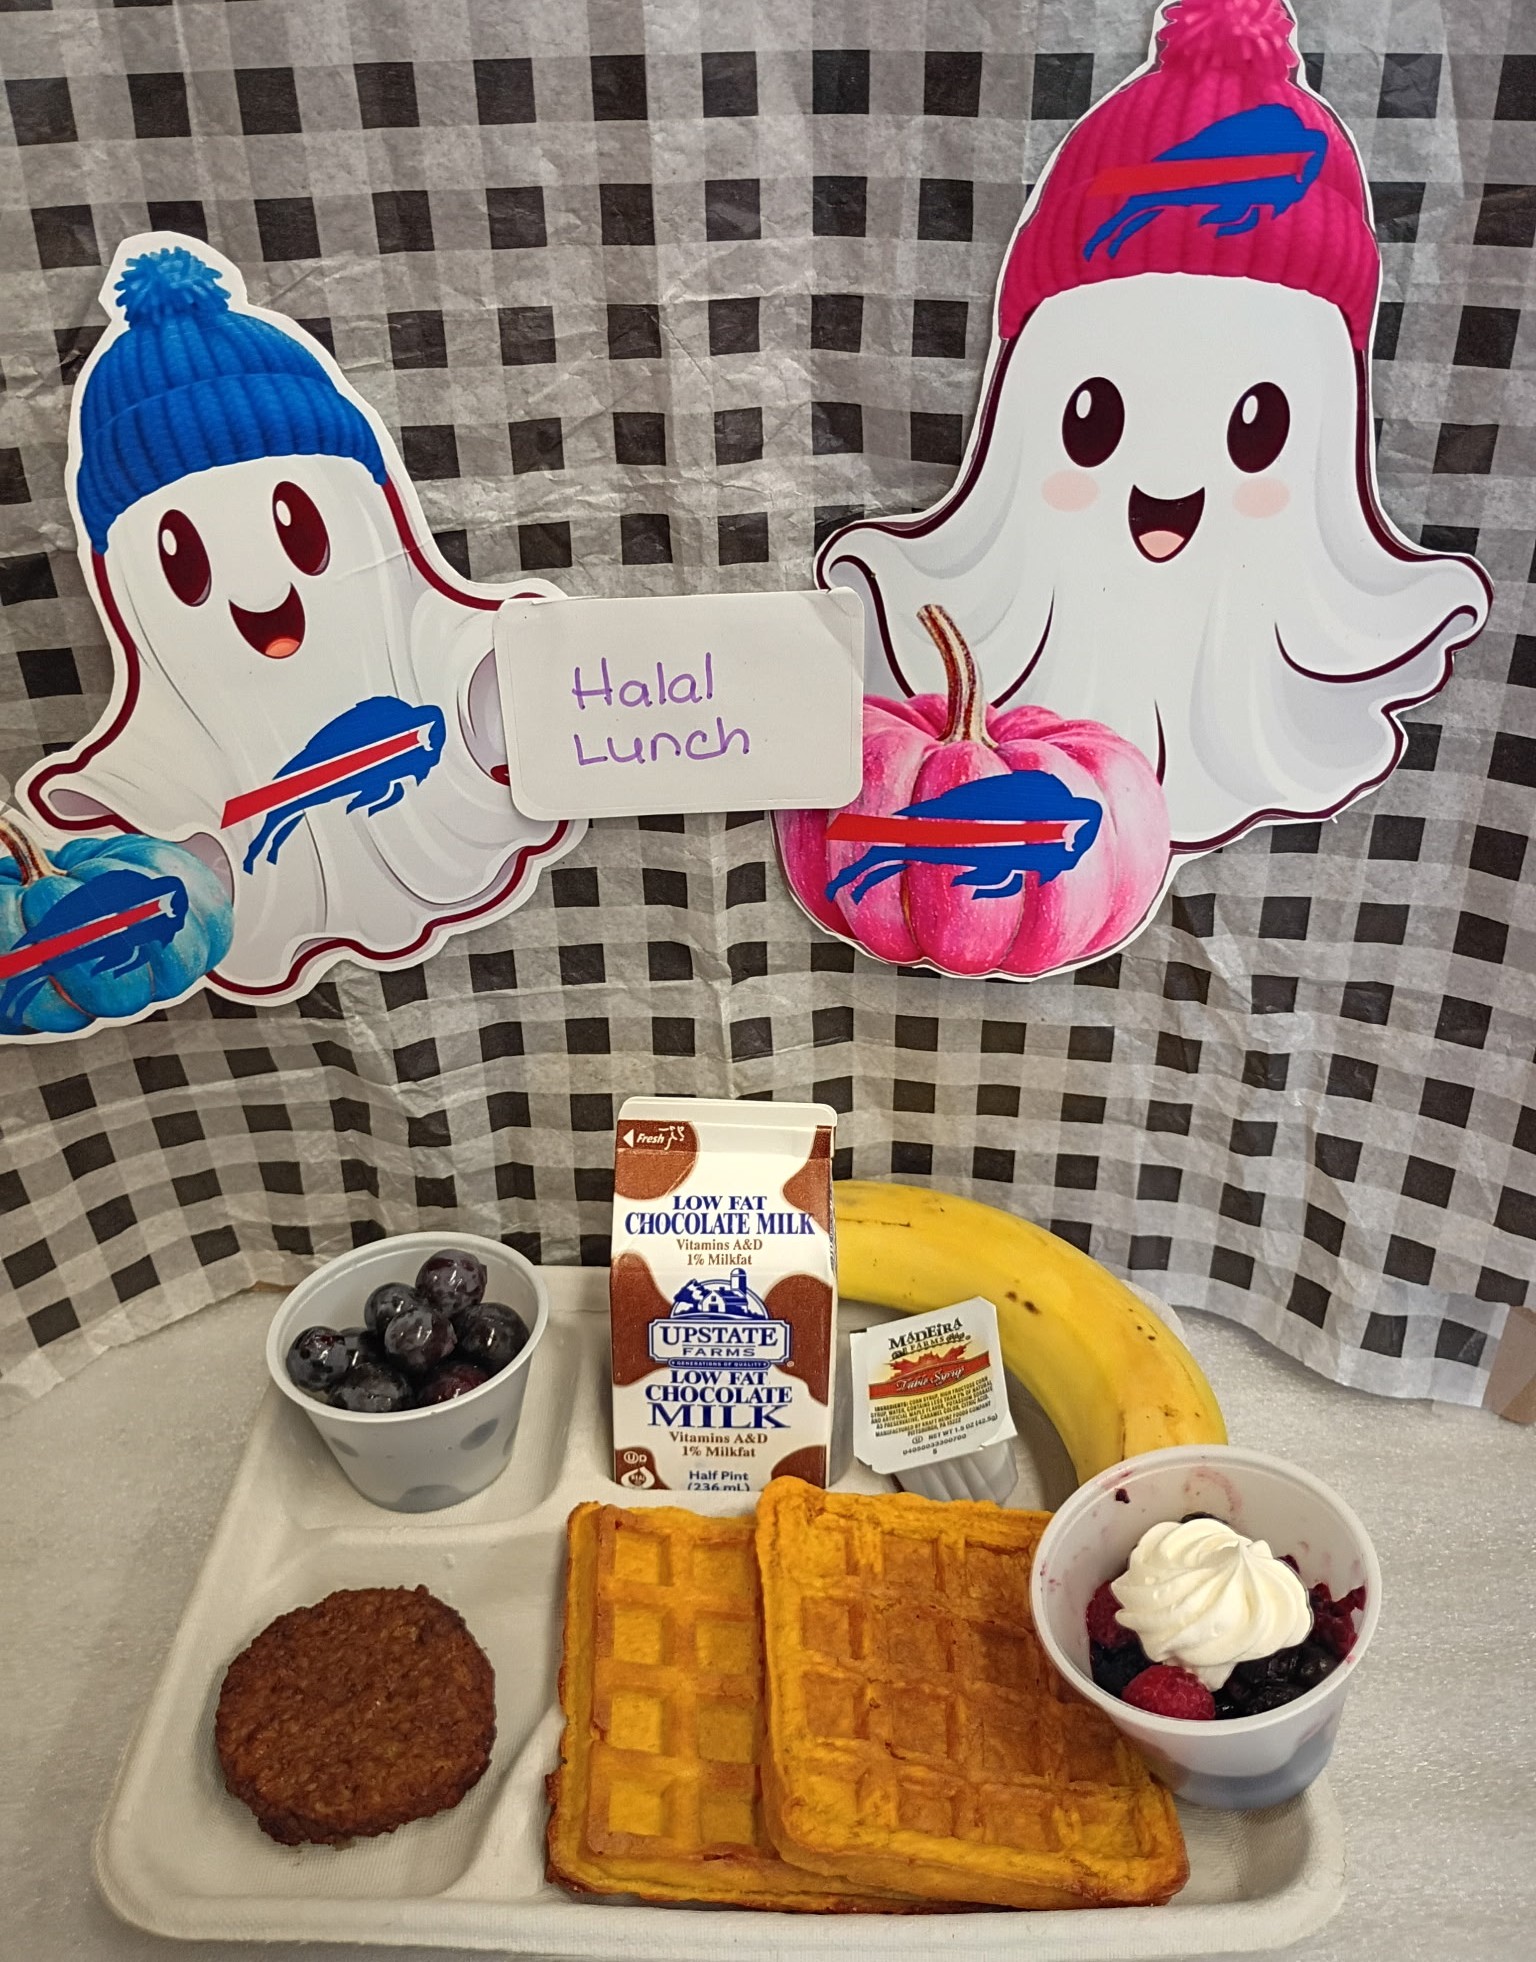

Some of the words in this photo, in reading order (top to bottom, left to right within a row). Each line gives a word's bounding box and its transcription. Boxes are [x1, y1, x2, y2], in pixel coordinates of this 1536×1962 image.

[572, 652, 713, 710] Halal
[573, 716, 749, 766] Lunch
[636, 1133, 665, 1144] Fresh
[673, 1195, 723, 1210] LOW
[729, 1196, 767, 1210] FAT
[625, 1212, 750, 1235] CHOCOLATE
[756, 1212, 815, 1235] MILK
[677, 1238, 730, 1251] Vitamins
[733, 1238, 763, 1251] A&D
[687, 1254, 704, 1265] 1%
[708, 1254, 752, 1265] Milkfat
[660, 1326, 778, 1346] UPSTATE
[911, 1336, 944, 1351] FARMS
[683, 1347, 756, 1357] FARMS
[670, 1370, 721, 1385] LOW
[729, 1371, 768, 1386] FAT
[931, 1366, 964, 1386] Syrup
[645, 1385, 792, 1404] CHOCOLATE
[647, 1402, 790, 1429] MILK
[669, 1431, 730, 1444] Vitamins
[734, 1433, 768, 1444] A&D
[928, 1432, 941, 1441] NET
[965, 1422, 974, 1430] OZ
[682, 1446, 701, 1457] 1%
[706, 1446, 755, 1458] Milkfat
[689, 1470, 718, 1480] Half
[721, 1471, 749, 1481] Pint
